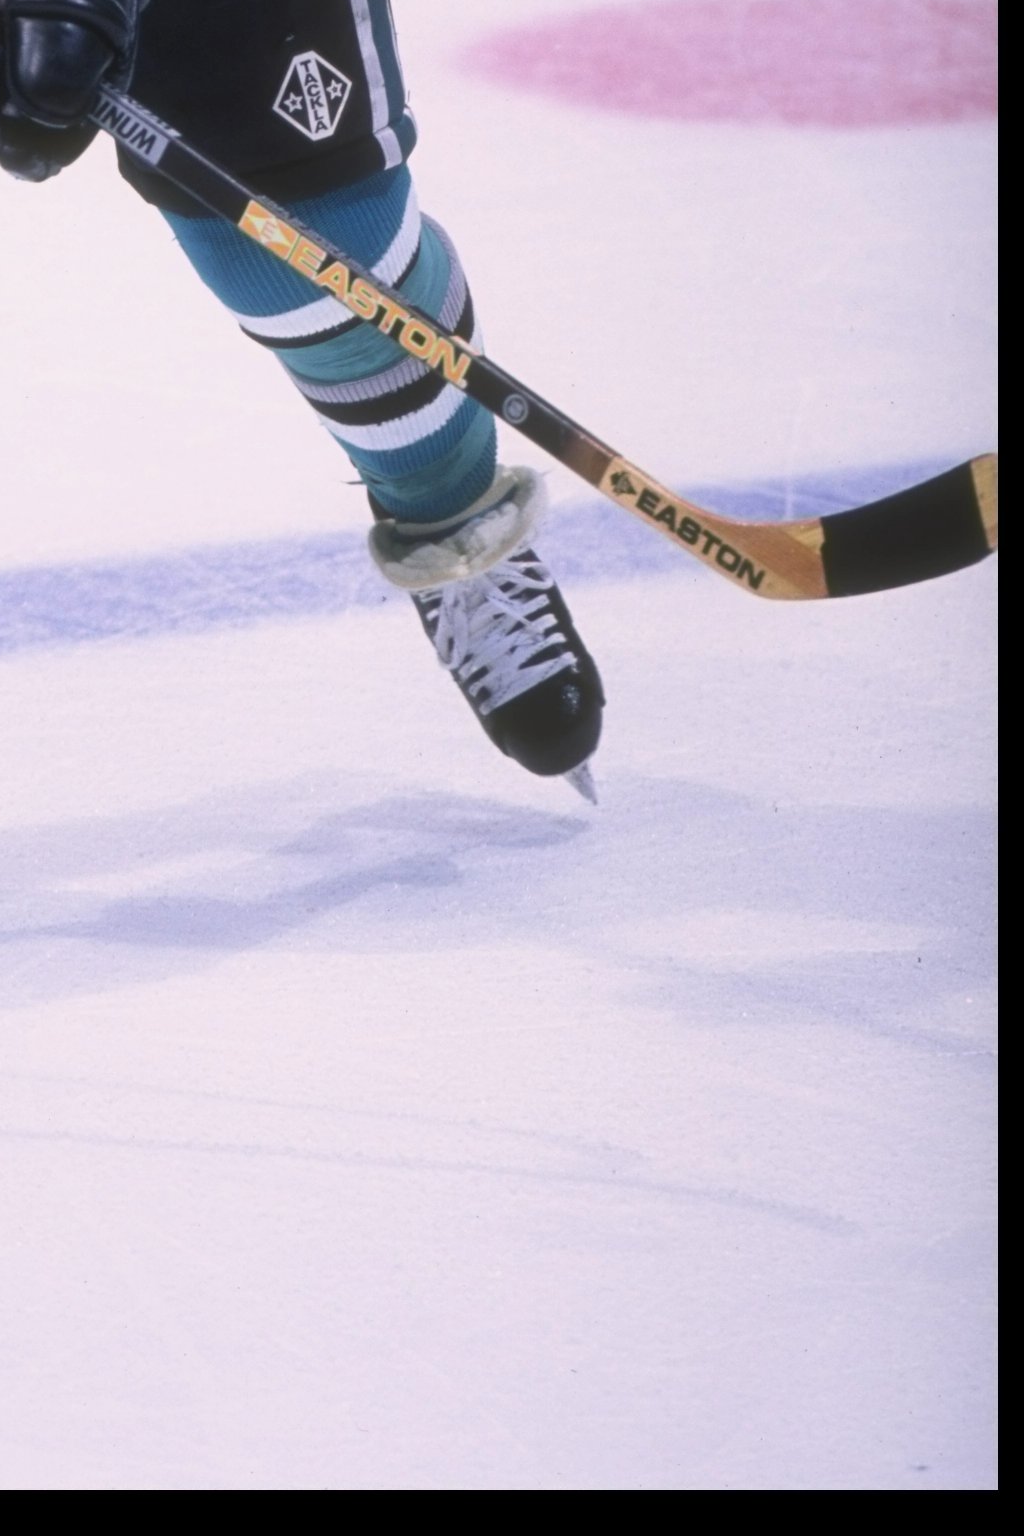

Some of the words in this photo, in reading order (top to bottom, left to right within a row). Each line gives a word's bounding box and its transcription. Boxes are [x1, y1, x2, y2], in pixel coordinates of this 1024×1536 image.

[299, 59, 329, 134] TACKLA
[287, 234, 472, 388] EASTON
[635, 486, 767, 591] EASTON
